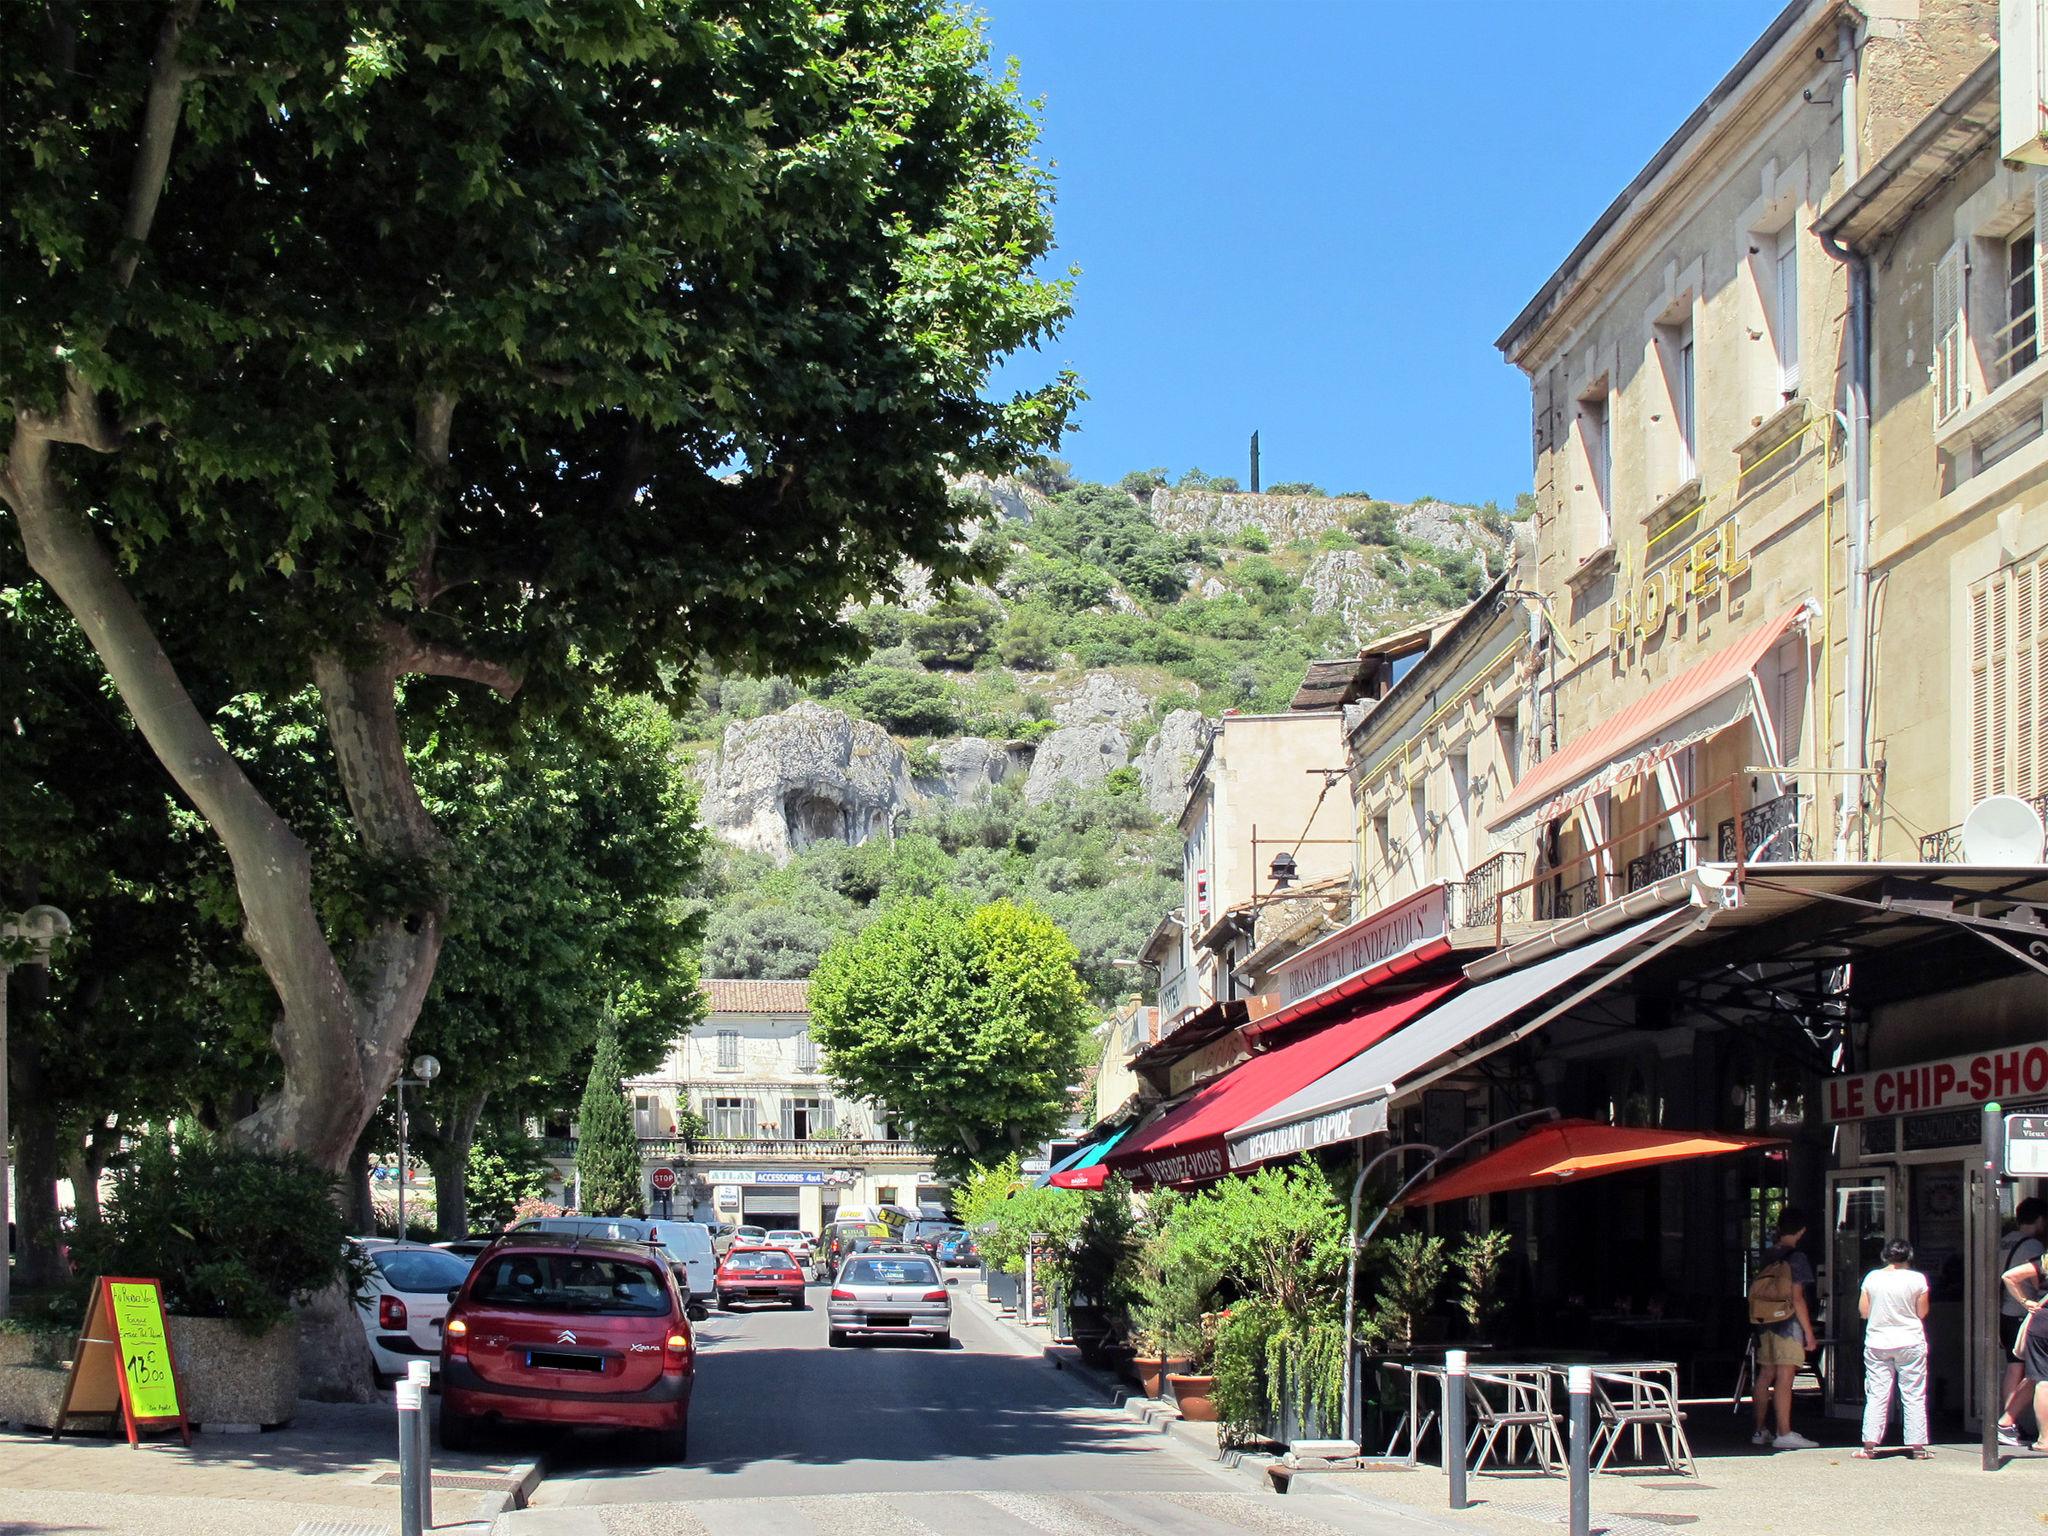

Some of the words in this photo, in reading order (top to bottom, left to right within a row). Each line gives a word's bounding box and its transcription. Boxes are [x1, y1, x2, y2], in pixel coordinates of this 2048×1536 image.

[1609, 514, 1752, 660] HOTEL
[1289, 951, 1331, 999] BRASSERIE
[1830, 1078, 1864, 1119] LE
[1250, 1123, 1307, 1160] RESTAURANT
[1313, 1109, 1352, 1144] RAPIDE
[654, 1173, 674, 1183] STOP
[711, 1171, 754, 1181] ATLAS
[757, 1173, 804, 1183] ACCESSOIRES
[806, 1173, 821, 1183] 4x4
